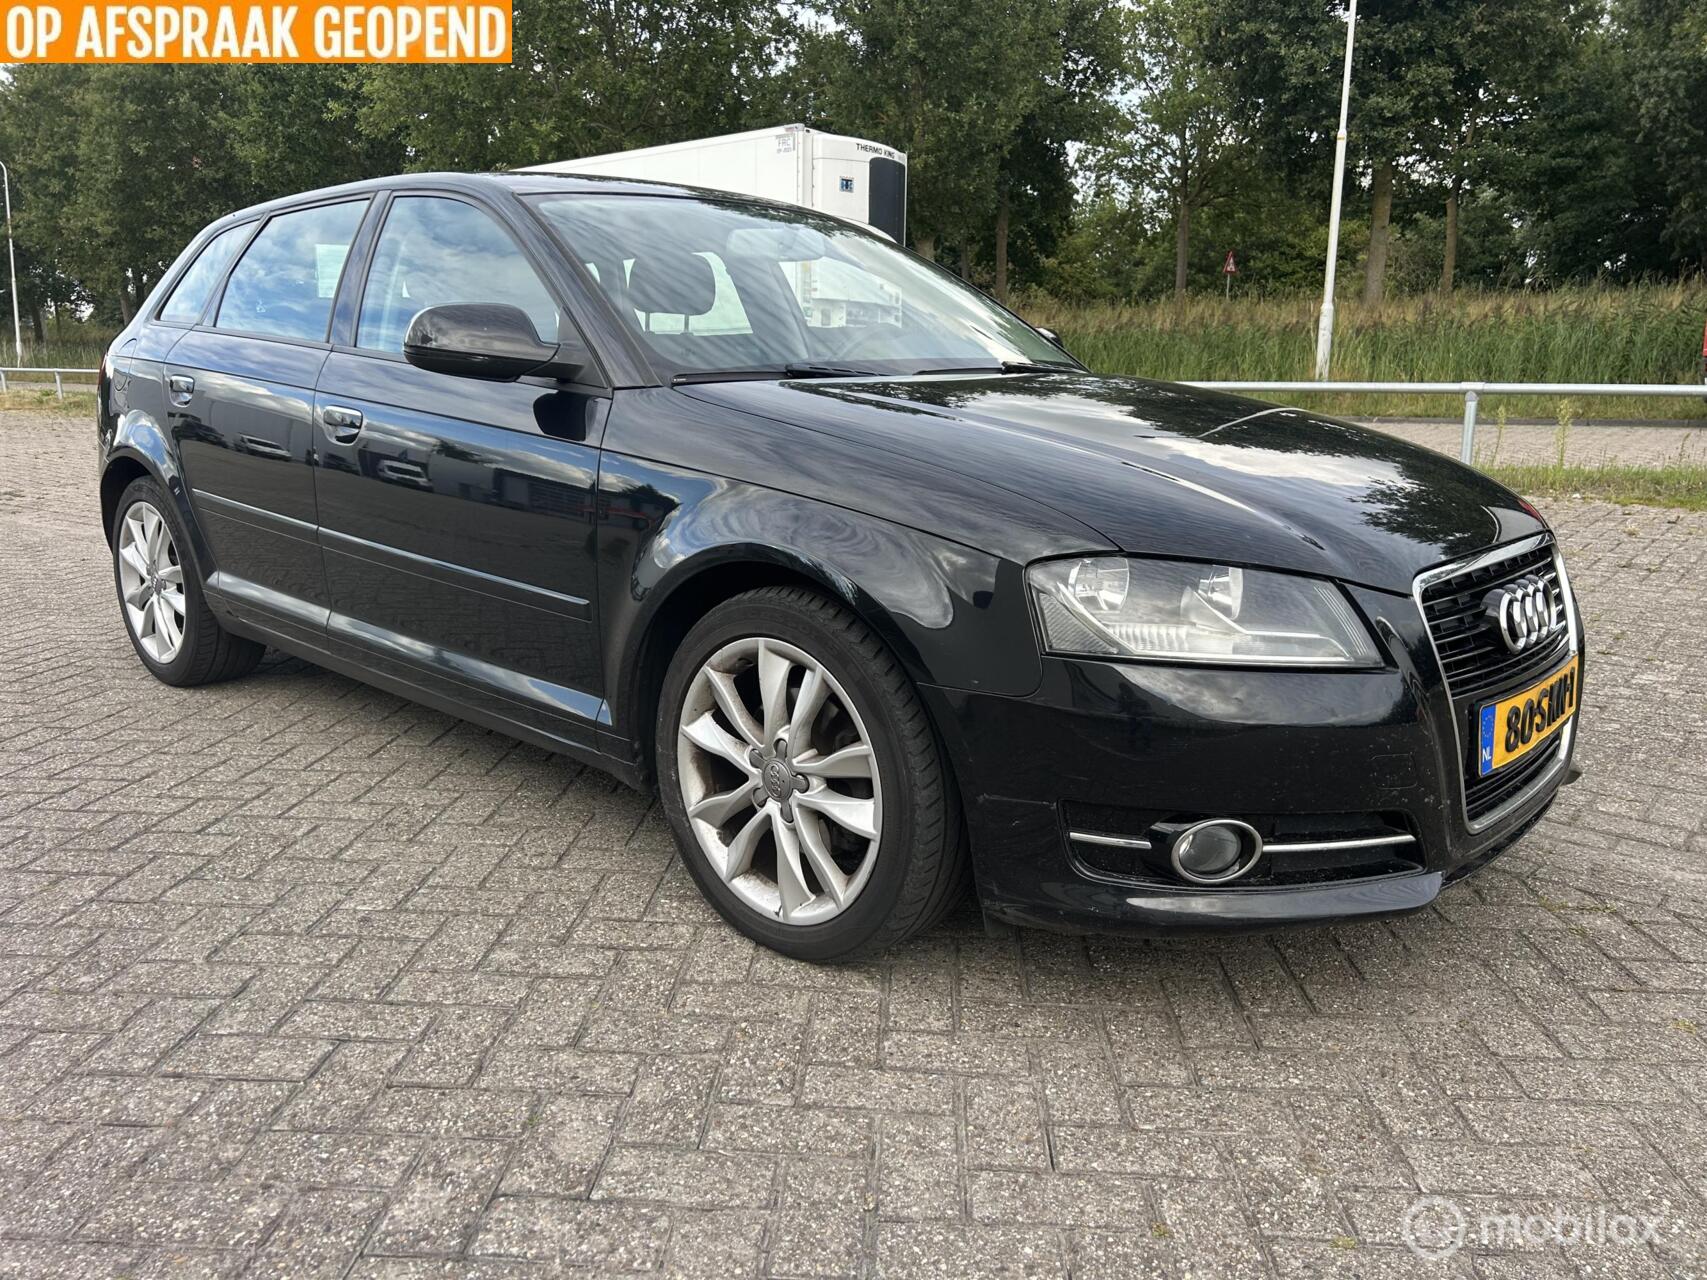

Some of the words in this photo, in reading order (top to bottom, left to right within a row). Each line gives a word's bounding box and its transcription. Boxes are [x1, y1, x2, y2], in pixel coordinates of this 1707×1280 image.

[856, 143, 883, 155] THERMO
[884, 150, 896, 159] KING
[1482, 747, 1491, 762] NL
